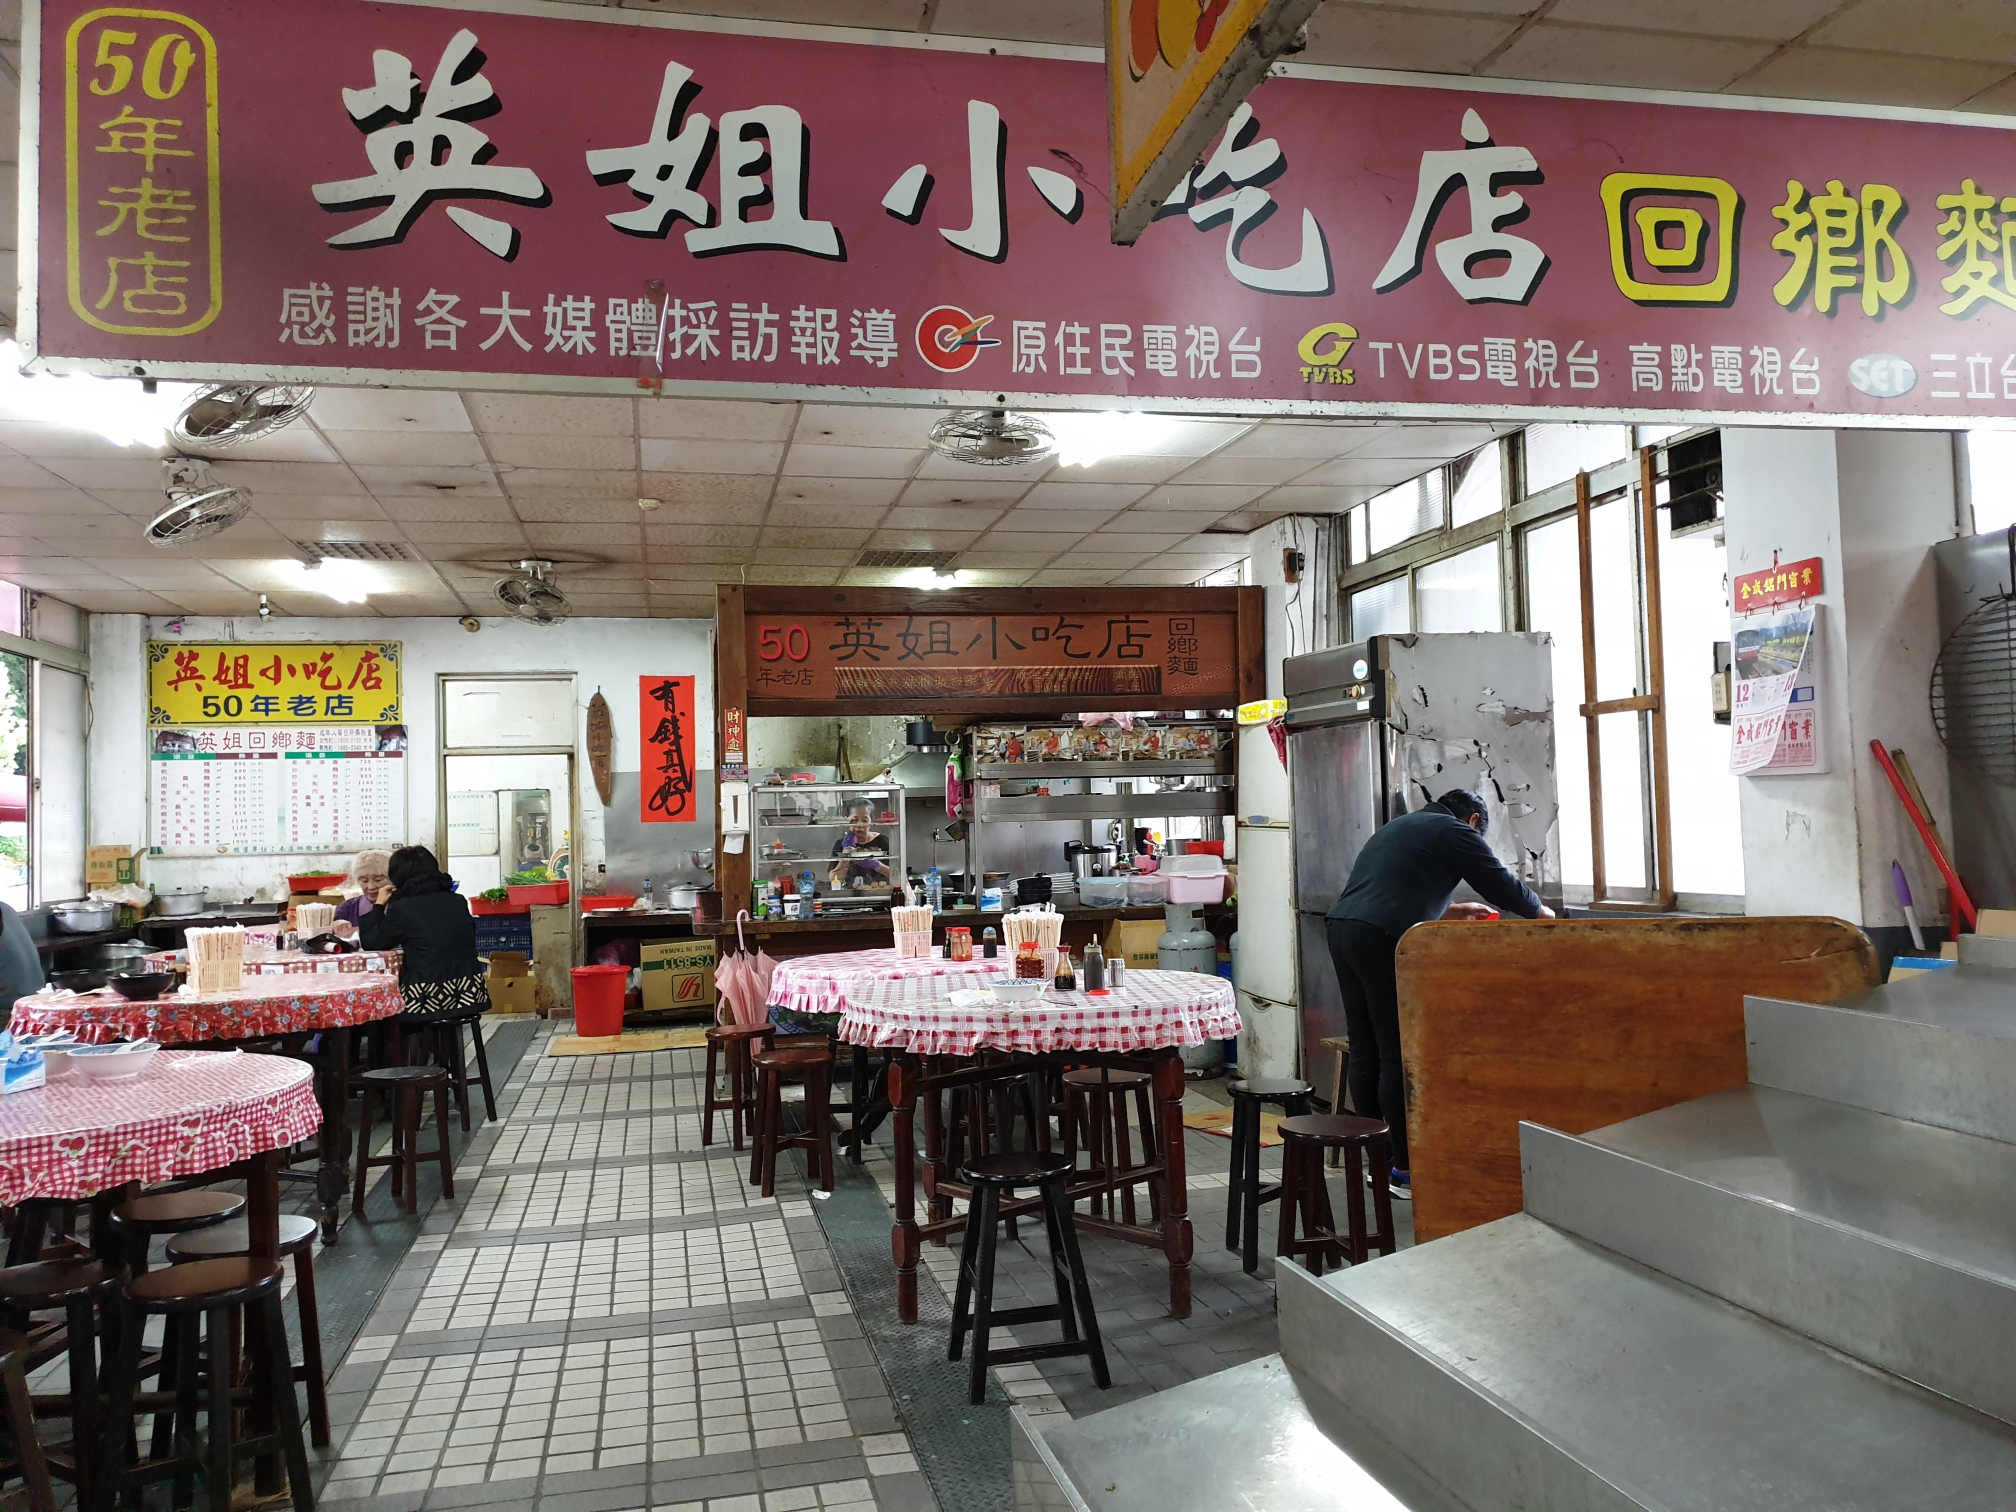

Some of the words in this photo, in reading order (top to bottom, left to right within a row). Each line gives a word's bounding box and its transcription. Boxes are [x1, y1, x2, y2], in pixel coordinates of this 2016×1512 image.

[312, 28, 1546, 302] 英姐小吃店
[279, 281, 899, 368] 感謝各大媒體採訪報導
[1012, 320, 1262, 379] 原住民電視台
[1299, 366, 1356, 386] TVBS
[1629, 343, 1821, 396] 高點電視台
[1849, 358, 1908, 393] SET
[758, 624, 810, 662] 50
[829, 614, 1153, 662] 英姐小吃店
[166, 649, 383, 693] 英姐小吃店
[756, 666, 814, 687] 年老店
[202, 694, 354, 718] 50年老店
[1735, 683, 1750, 703] 12
[198, 730, 316, 751] 英姐回鄉麵
[648, 680, 693, 817] 有錢真好
[660, 947, 684, 955] TAIWAN
[663, 954, 713, 971] YS-8511
[695, 944, 712, 952] MADE
